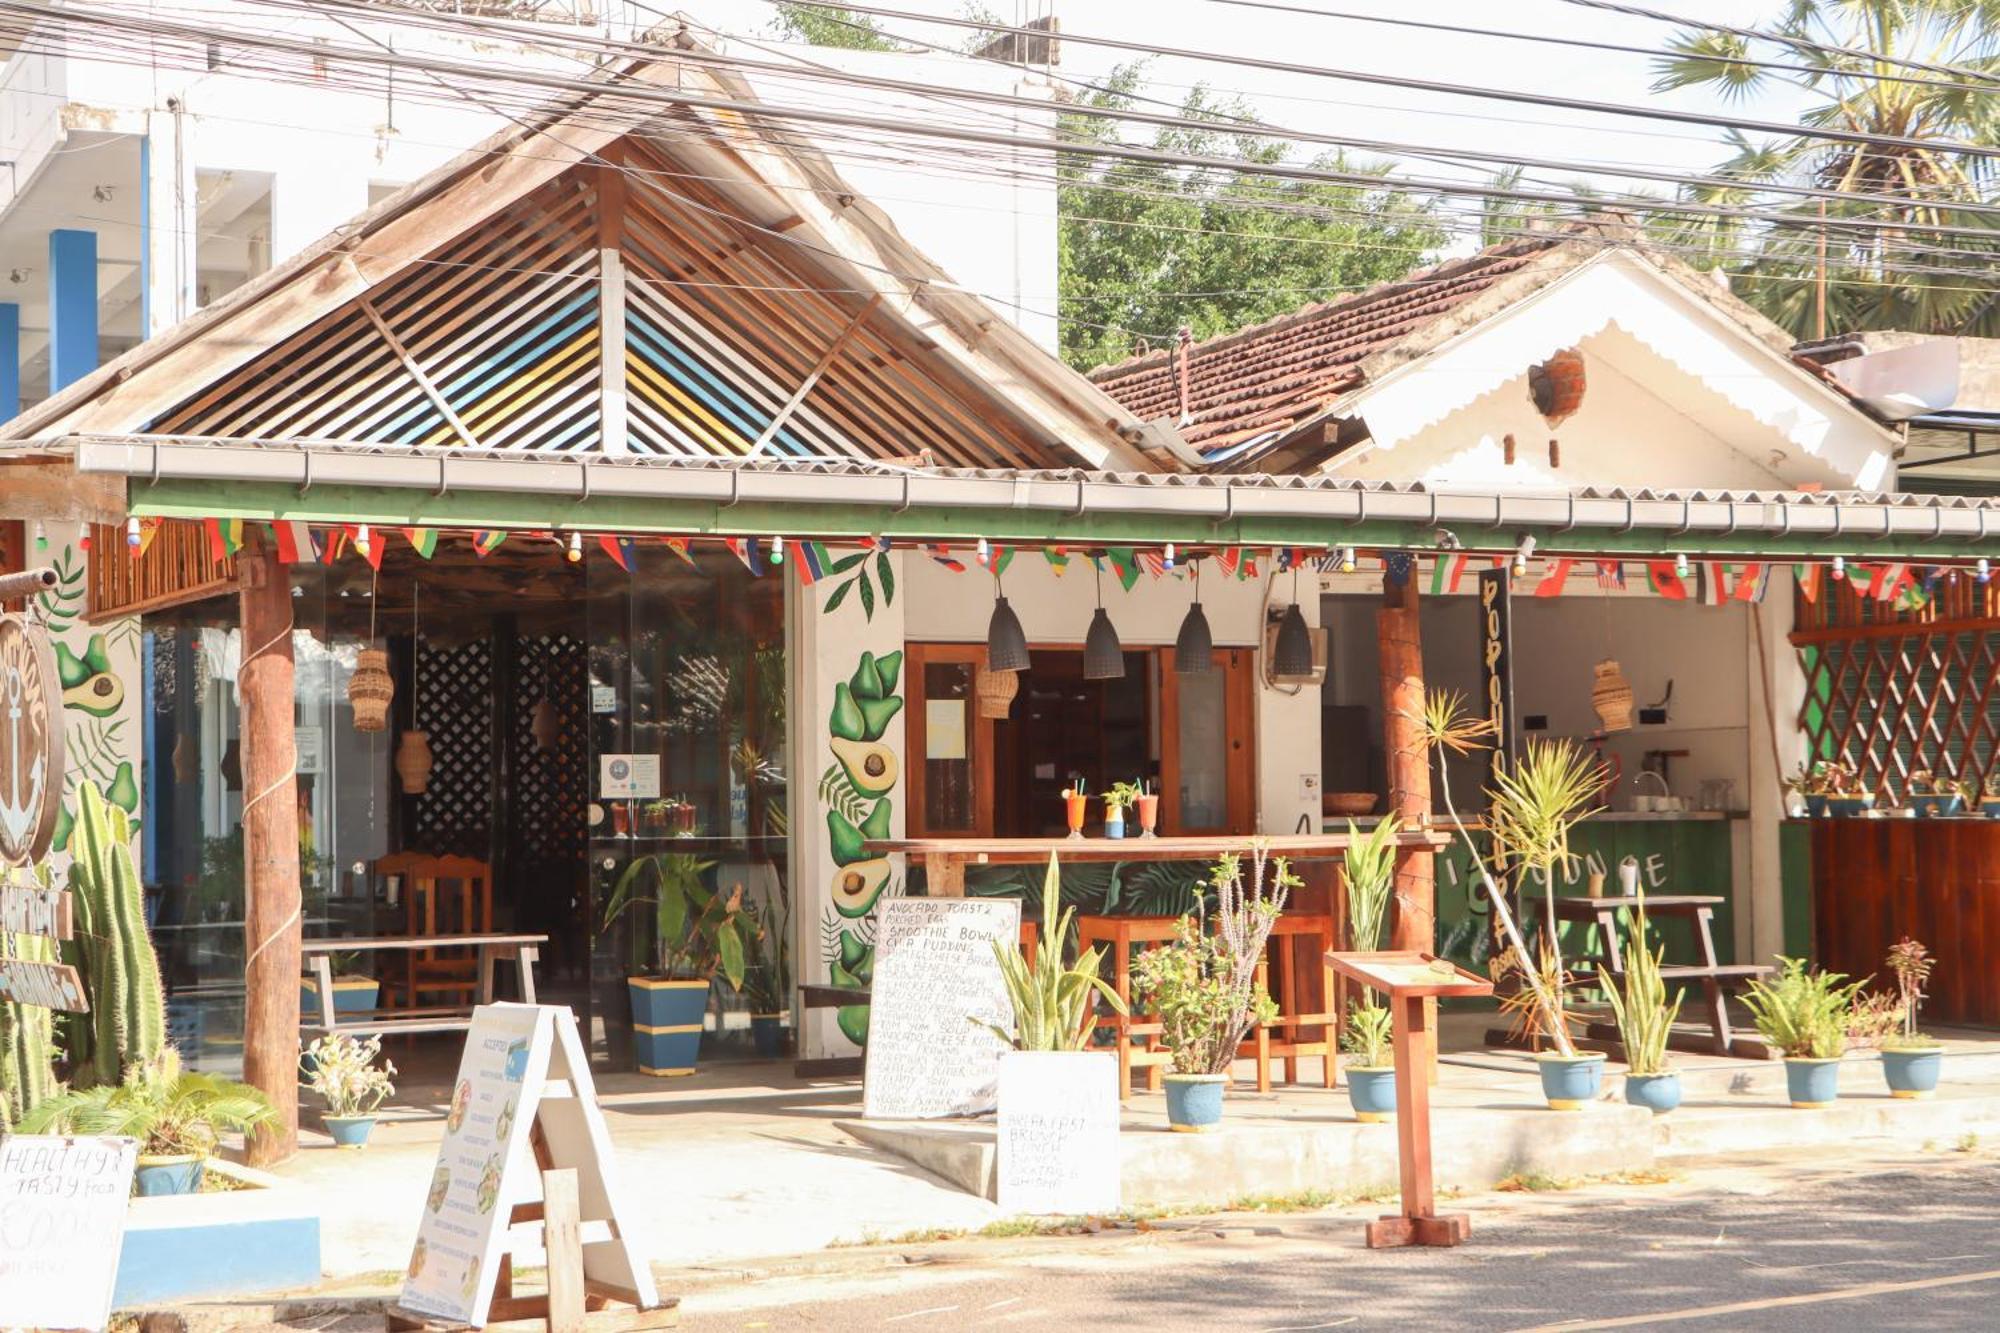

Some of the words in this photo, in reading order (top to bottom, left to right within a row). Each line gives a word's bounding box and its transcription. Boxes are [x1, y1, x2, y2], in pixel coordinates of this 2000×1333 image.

[887, 902, 938, 914] AVOCADO
[947, 903, 983, 914] TOAST
[889, 926, 950, 939] SMOOTHIE
[4, 1146, 108, 1176] HEALTHY
[16, 1175, 79, 1199] TASTY
